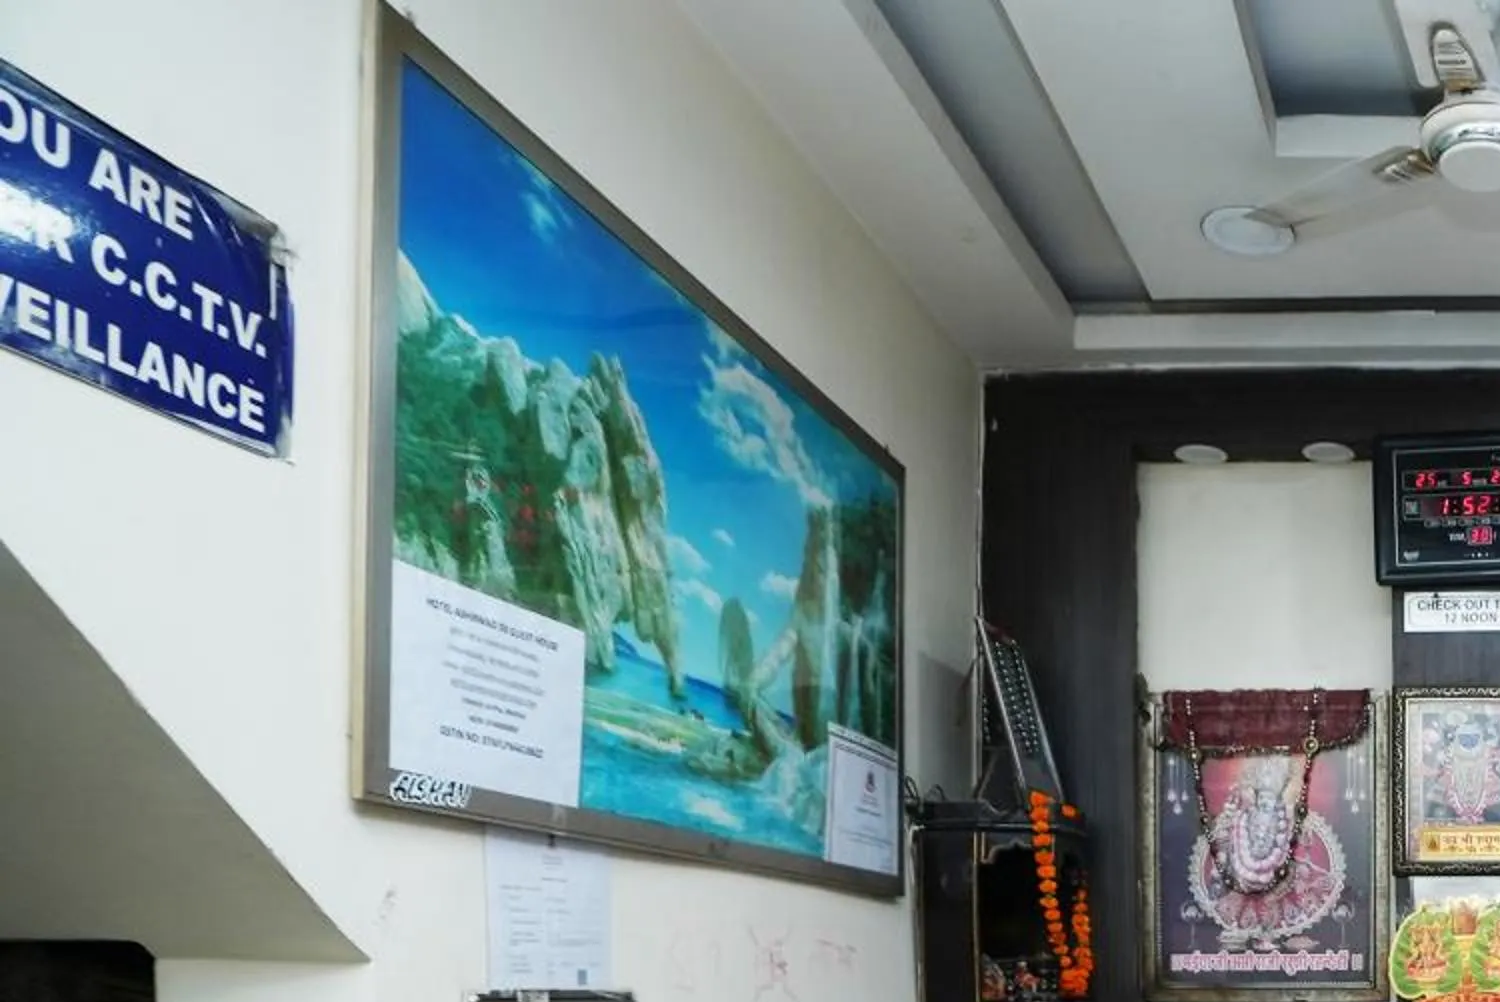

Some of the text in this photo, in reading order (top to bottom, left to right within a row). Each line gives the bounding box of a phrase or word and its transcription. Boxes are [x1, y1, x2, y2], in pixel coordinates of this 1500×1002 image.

[89, 149, 193, 240] ARE
[91, 233, 267, 357] C.C.T.V.
[1444, 613, 1498, 624] 12 NOON
